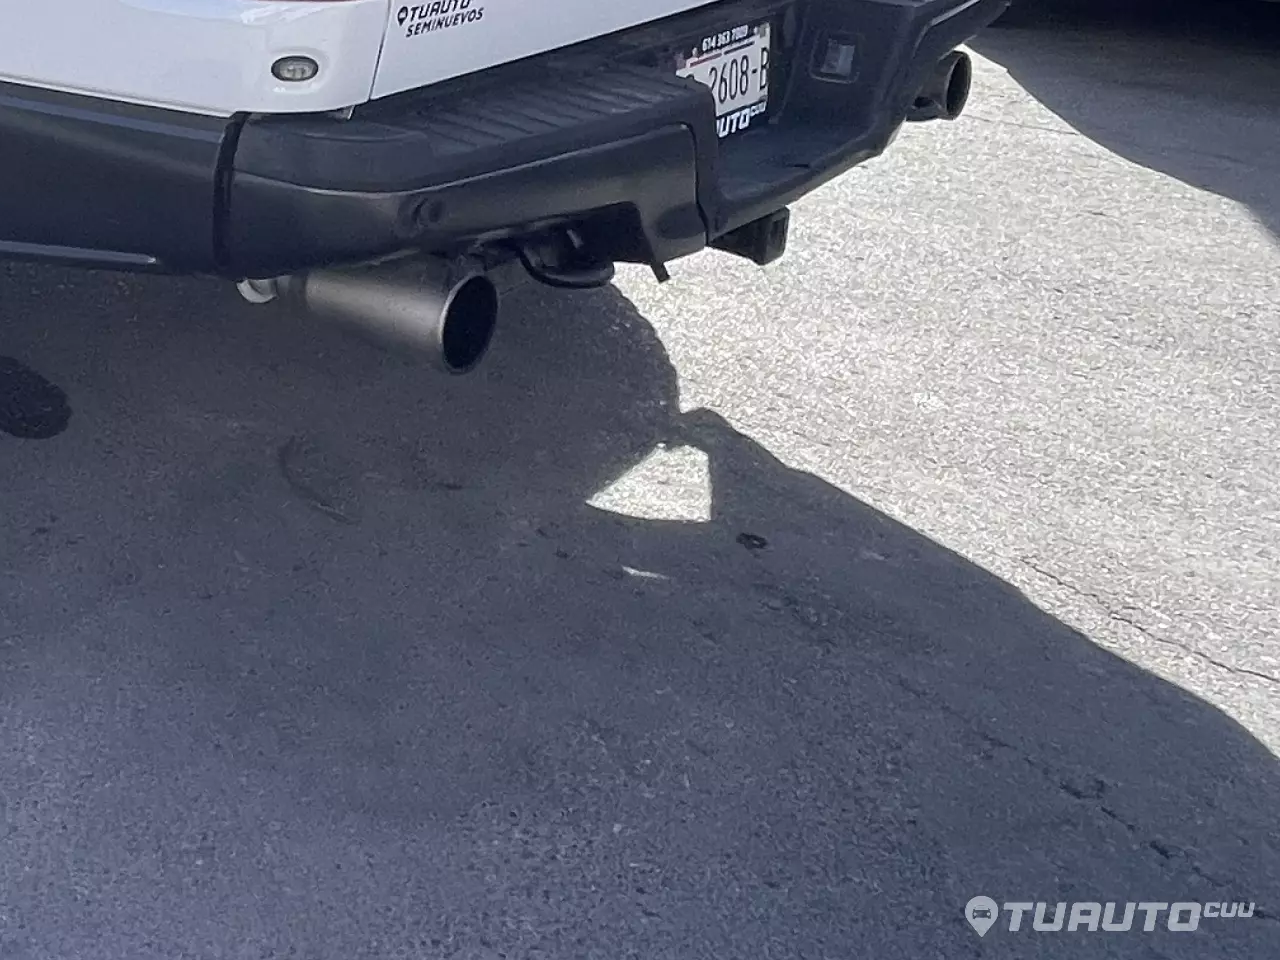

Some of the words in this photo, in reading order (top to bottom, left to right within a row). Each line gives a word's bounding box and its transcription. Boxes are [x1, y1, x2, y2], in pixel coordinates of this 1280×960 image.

[405, 7, 484, 38] SEMINUEVOS
[687, 47, 770, 104] 2608-B
[716, 108, 751, 138] UTO
